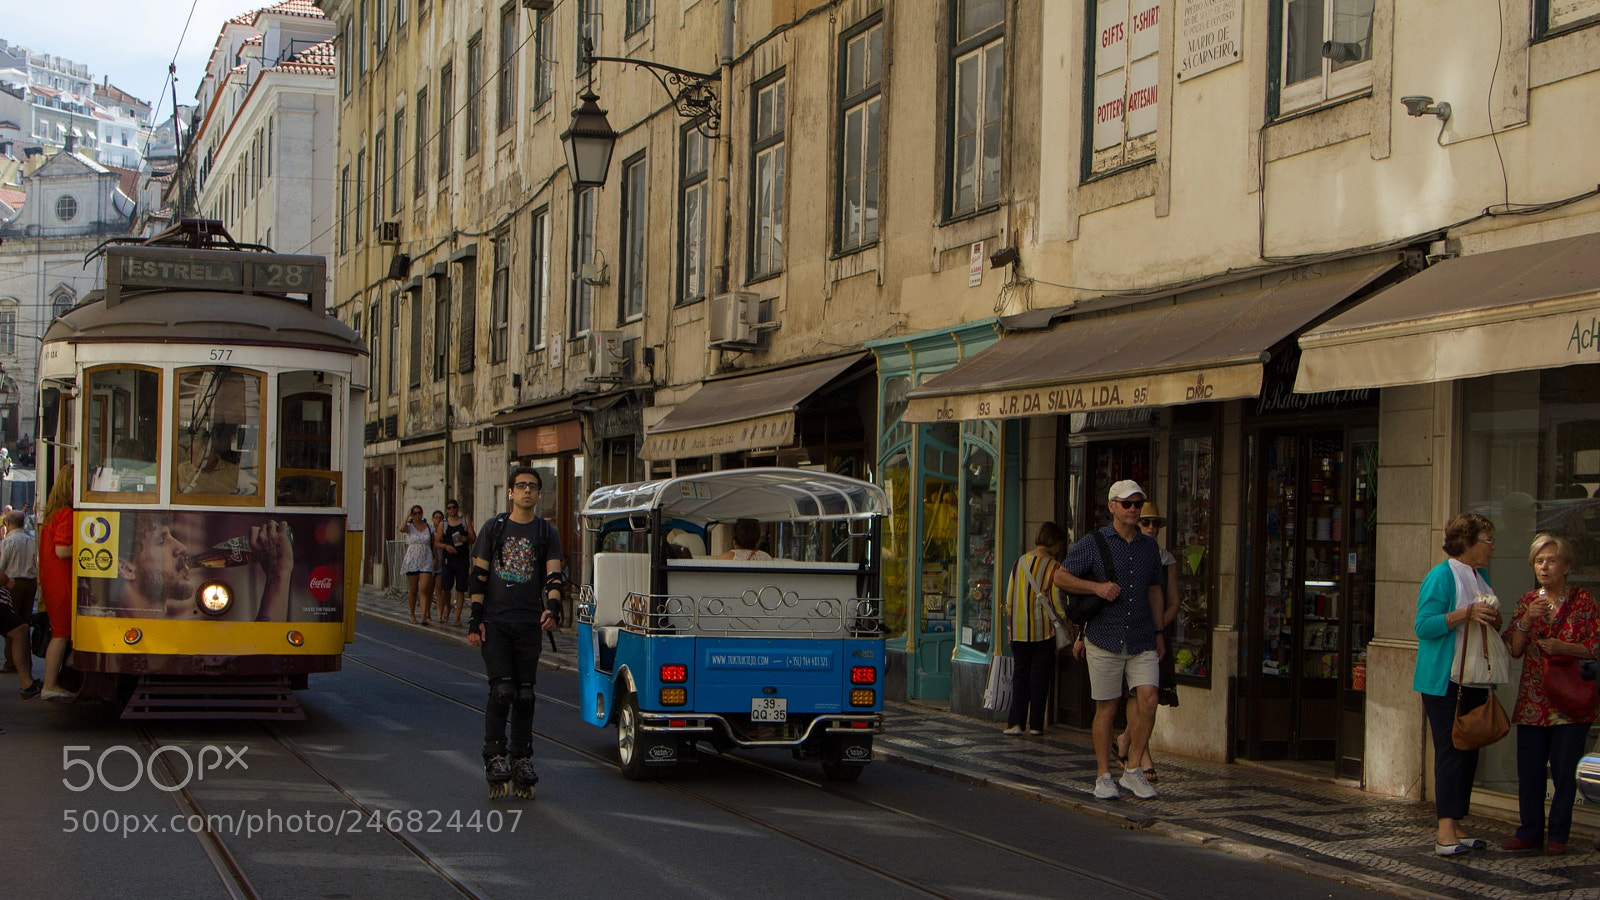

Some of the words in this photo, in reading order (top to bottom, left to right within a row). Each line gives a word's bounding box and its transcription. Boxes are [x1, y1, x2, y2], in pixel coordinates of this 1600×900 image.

[1102, 21, 1124, 48] GIFTS
[1217, 26, 1230, 42] DE
[1097, 98, 1124, 124] POTTERY
[130, 259, 234, 282] ESTRELA
[267, 263, 303, 286] 28
[210, 349, 233, 360] 577
[937, 408, 954, 419] DMC
[980, 402, 991, 415] 93
[1023, 393, 1040, 412] DA
[1047, 388, 1086, 410] SILVA,
[1092, 385, 1123, 407] LDA.
[1133, 387, 1147, 403] 95
[1186, 385, 1213, 400] DMC
[763, 699, 775, 709] 39
